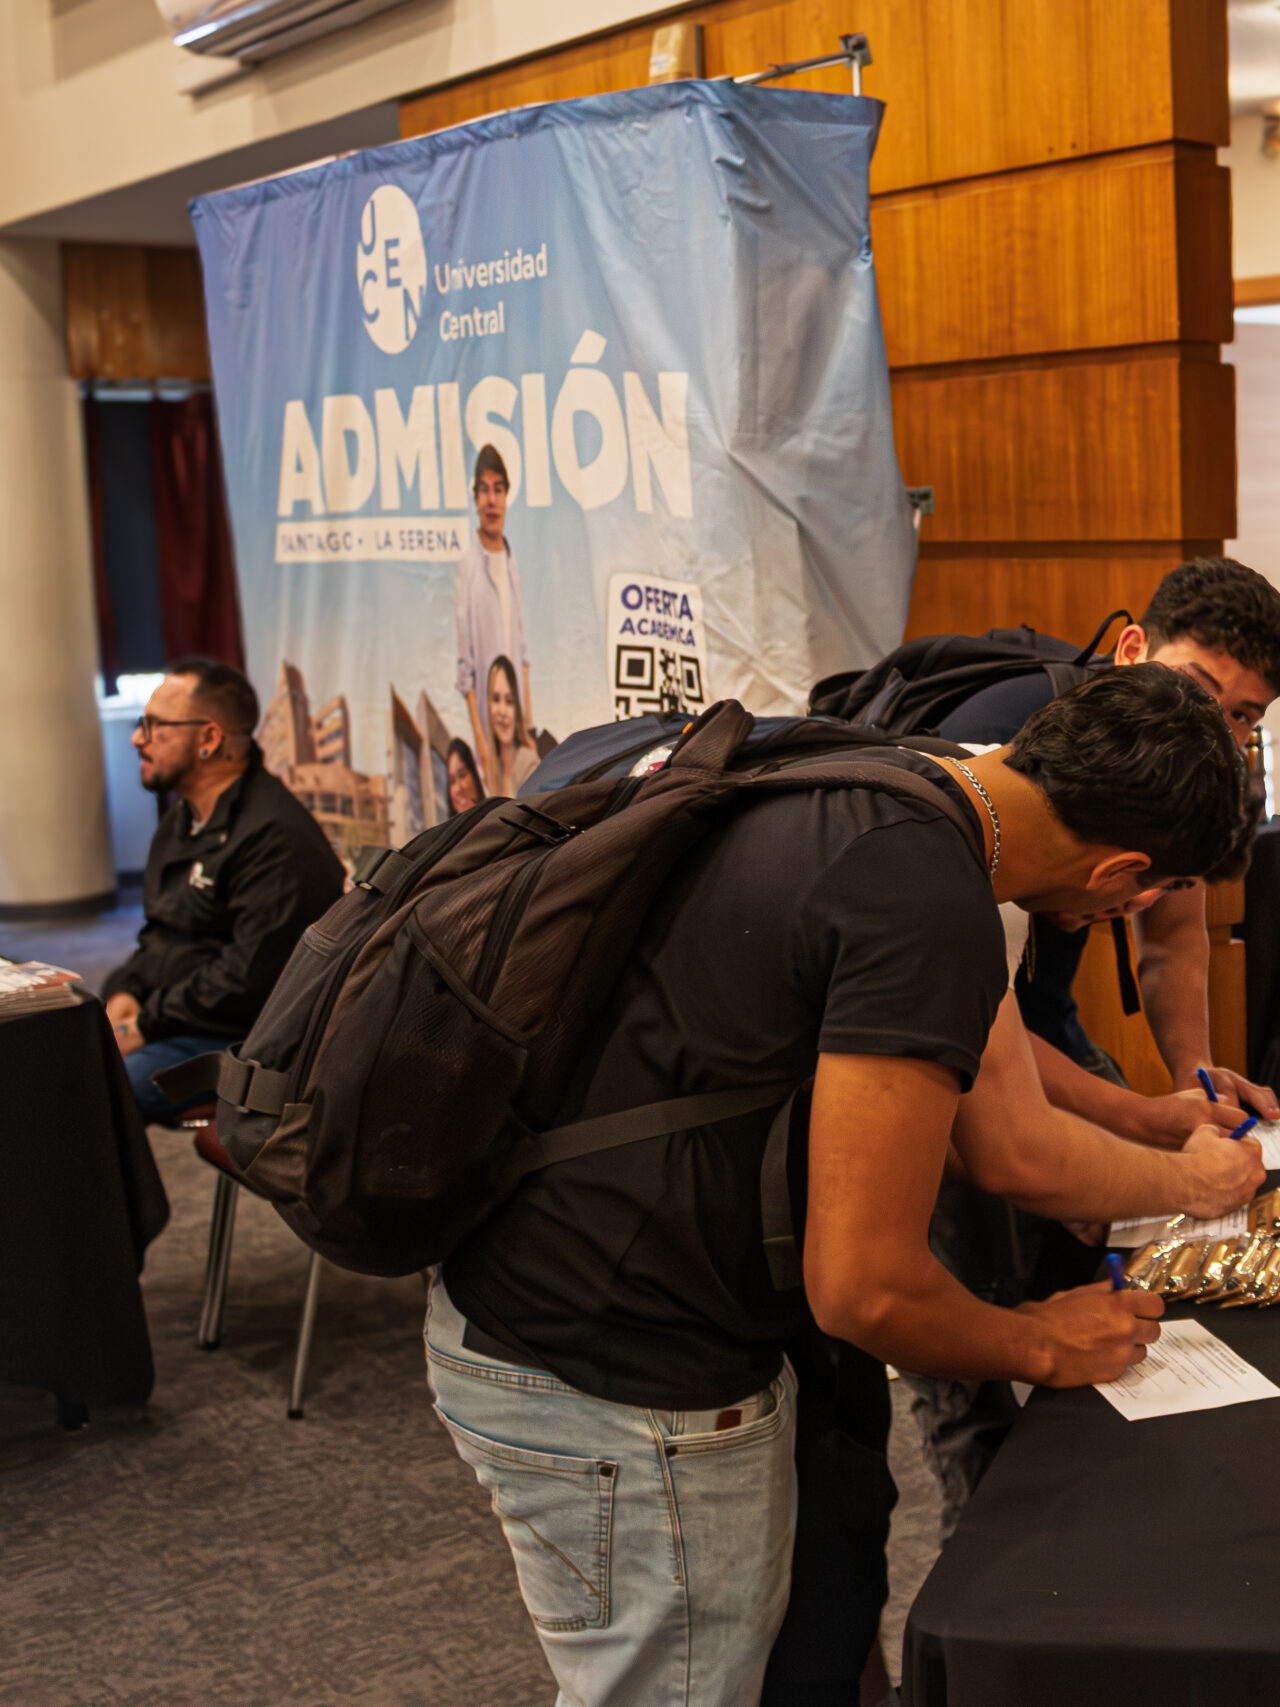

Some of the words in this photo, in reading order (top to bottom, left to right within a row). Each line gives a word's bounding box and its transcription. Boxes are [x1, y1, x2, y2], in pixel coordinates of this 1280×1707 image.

[435, 243, 548, 294] Universidad
[439, 302, 505, 342] Central
[276, 329, 695, 519] ADMISIÓN
[375, 529, 394, 551] LA
[398, 528, 462, 552] SERENA
[620, 583, 694, 622] OFERTA
